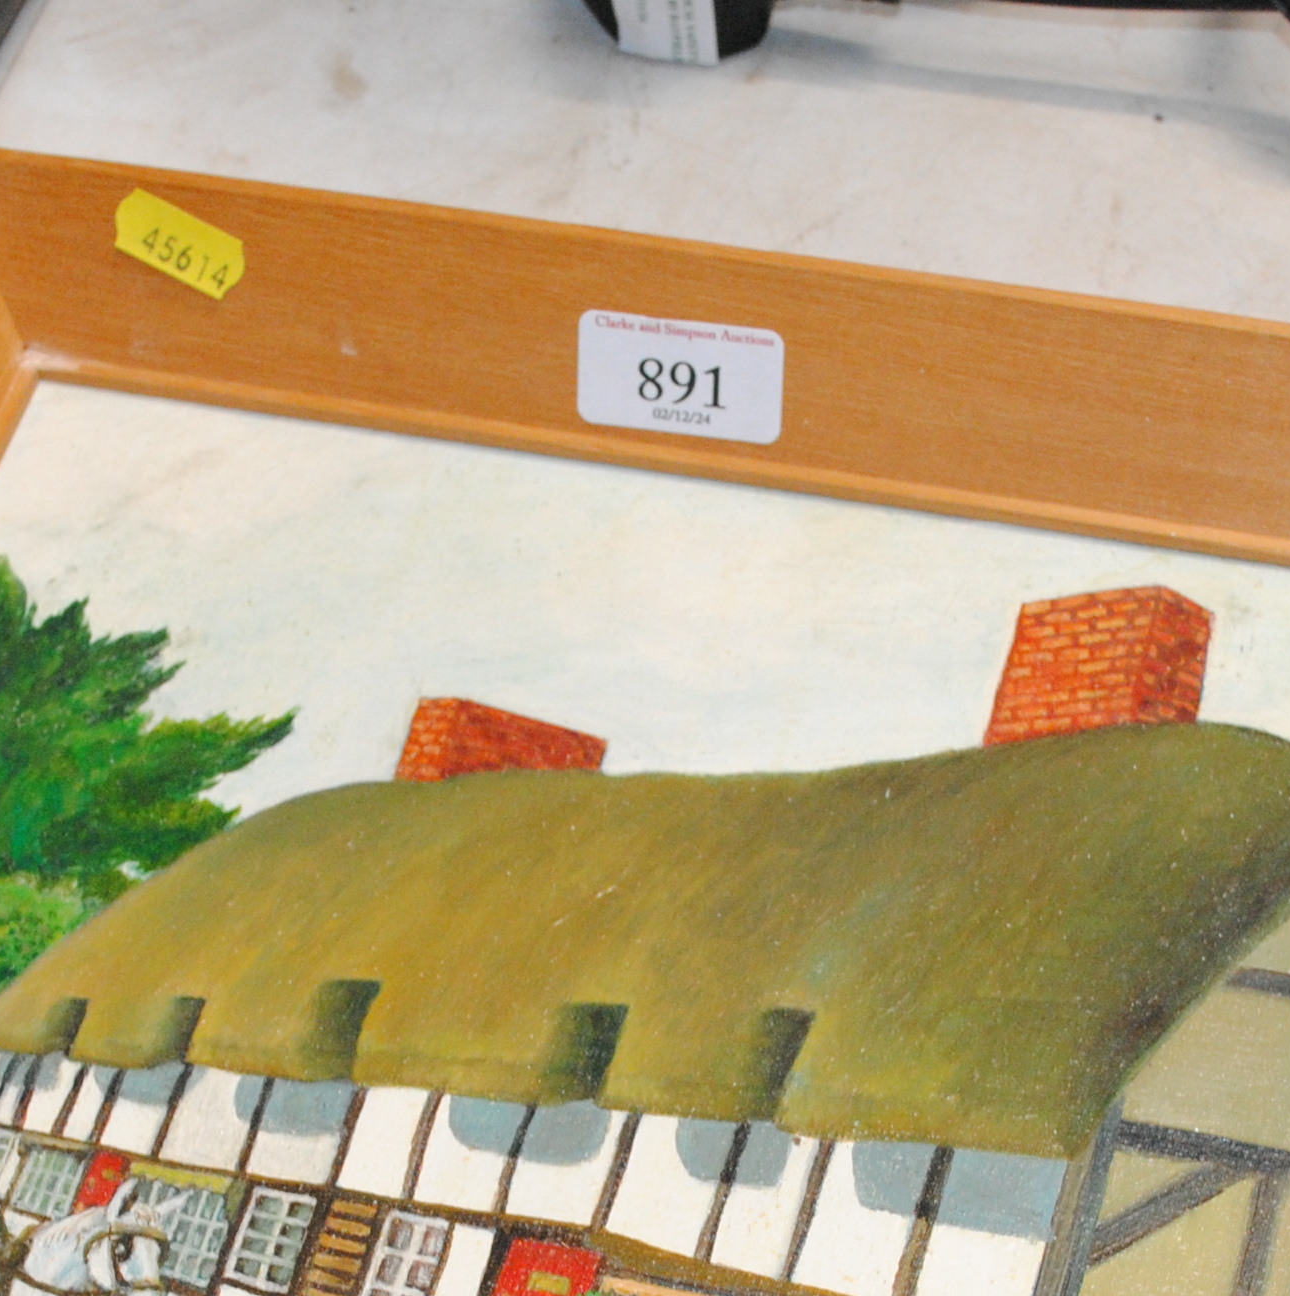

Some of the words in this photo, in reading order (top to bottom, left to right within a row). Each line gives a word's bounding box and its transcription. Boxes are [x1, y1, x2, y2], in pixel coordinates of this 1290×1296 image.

[141, 226, 230, 289] 45614
[595, 314, 635, 332] Clarke
[639, 321, 661, 335] and
[664, 323, 716, 342] Simpson
[721, 329, 774, 347] Auctions
[637, 357, 726, 411] 891
[651, 407, 712, 426] 02/12/24
